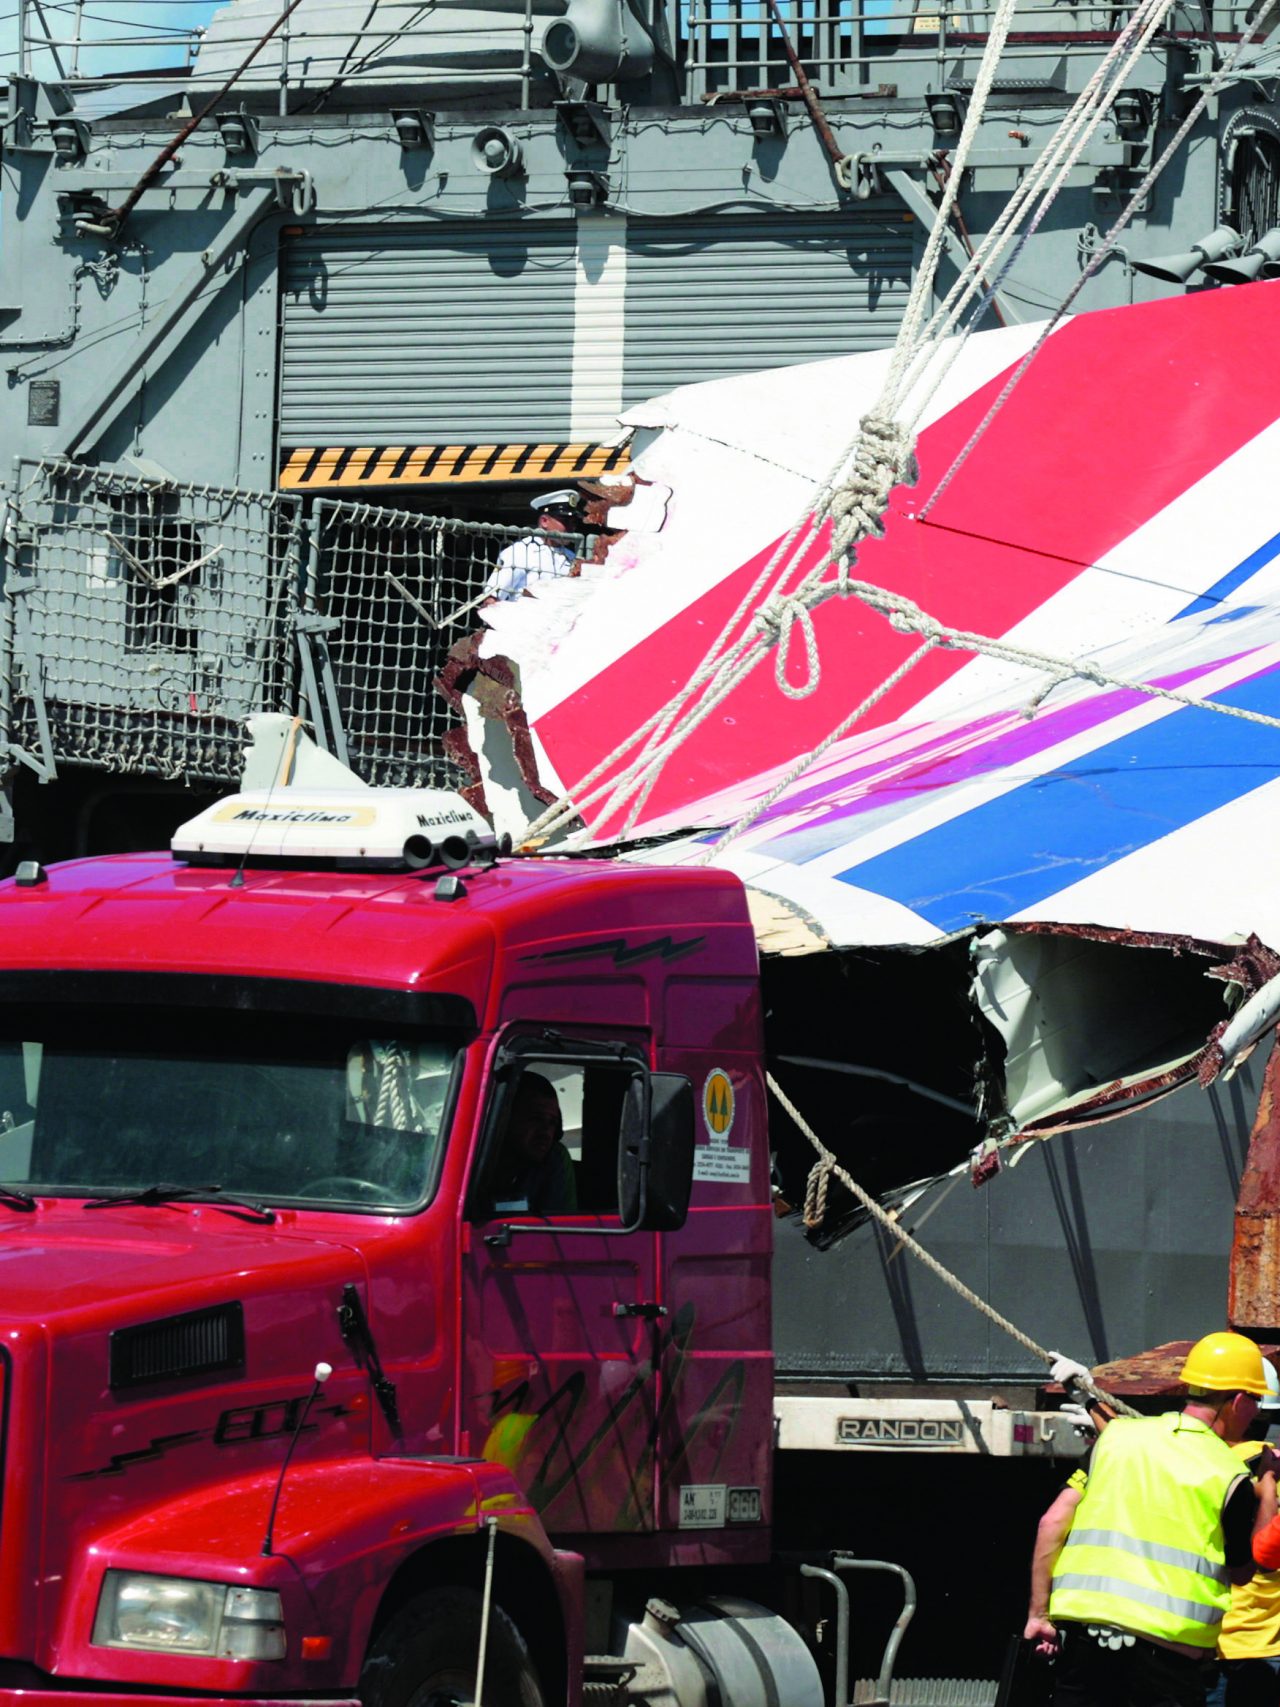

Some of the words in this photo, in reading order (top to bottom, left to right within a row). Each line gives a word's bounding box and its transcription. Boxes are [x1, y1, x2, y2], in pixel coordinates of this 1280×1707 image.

[232, 810, 352, 822] Maxiclima
[416, 810, 474, 828] Maxiclima
[841, 1420, 961, 1441] RANDON
